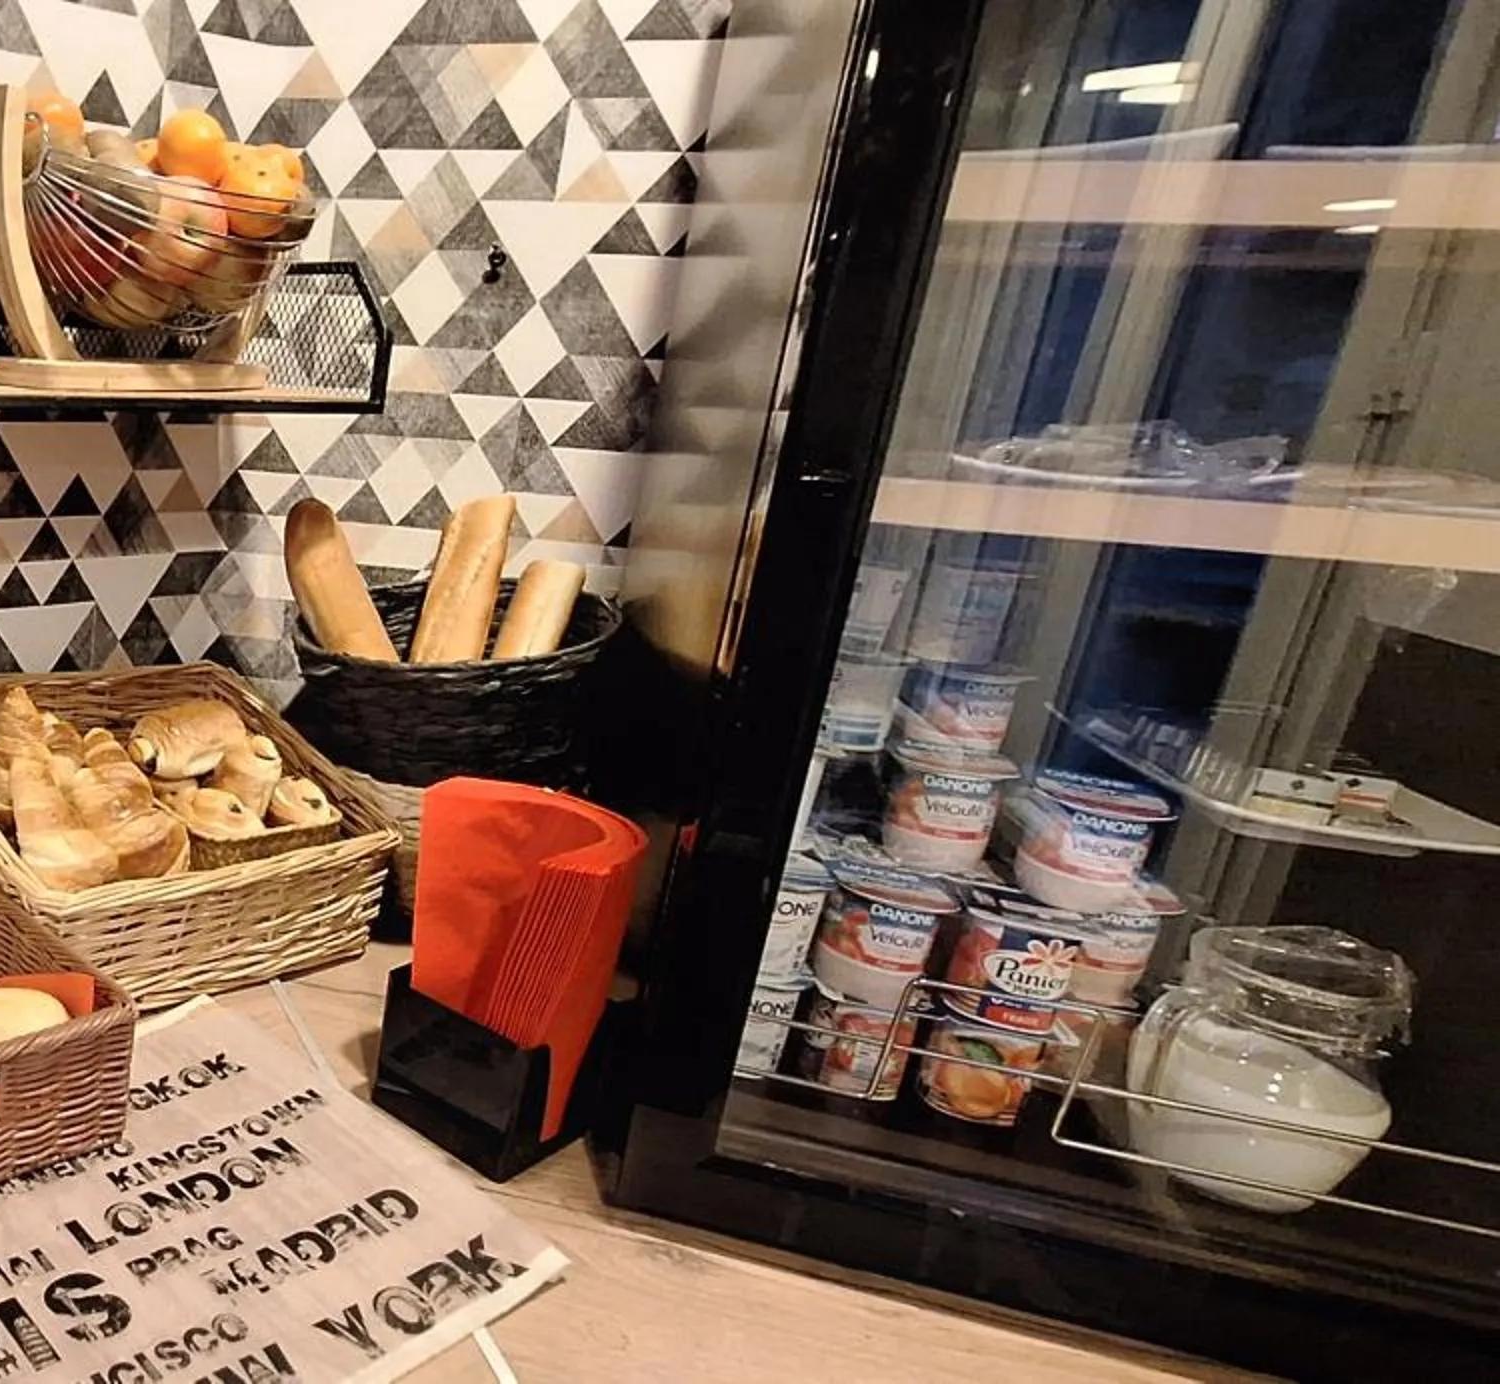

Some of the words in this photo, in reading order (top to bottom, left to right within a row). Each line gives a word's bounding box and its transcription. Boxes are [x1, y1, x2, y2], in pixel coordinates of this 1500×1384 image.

[924, 775, 993, 795] DANONE
[1072, 812, 1149, 836] DANONE
[777, 900, 818, 918] ONE
[995, 956, 1067, 990] Panier
[129, 1053, 246, 1110] GKOK
[106, 1088, 327, 1193] KINGSTOWN
[65, 1137, 311, 1255] LONDON
[125, 1226, 244, 1284] PRAG
[200, 1188, 420, 1300] MADRID
[311, 1233, 530, 1360] YORK
